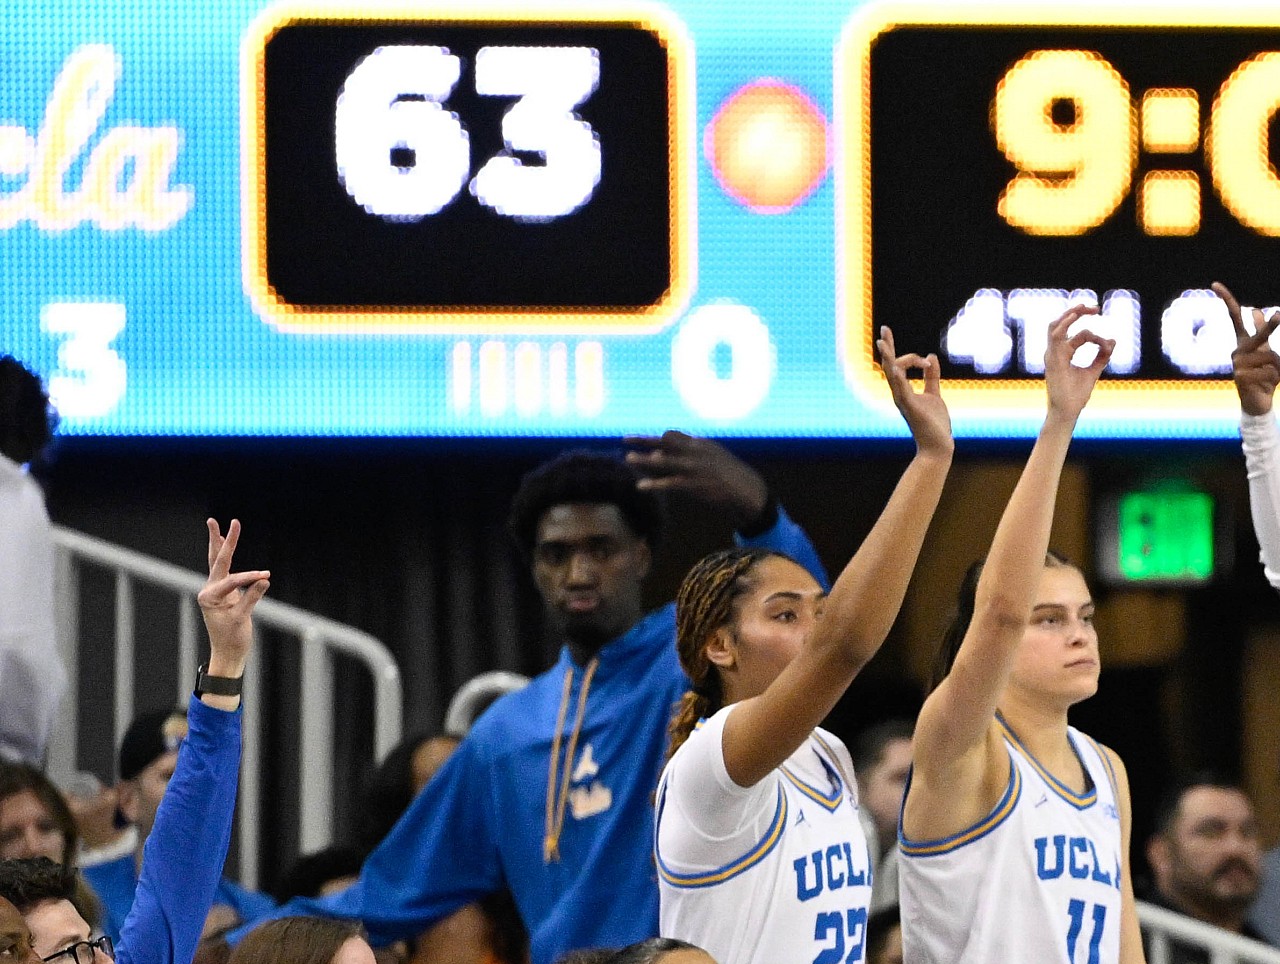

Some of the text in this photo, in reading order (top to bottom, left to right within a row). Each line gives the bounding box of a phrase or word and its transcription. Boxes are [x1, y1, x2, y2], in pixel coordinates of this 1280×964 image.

[335, 45, 601, 221] 63
[40, 301, 128, 418] 3
[671, 297, 777, 421] 0
[793, 842, 873, 902] UCL
